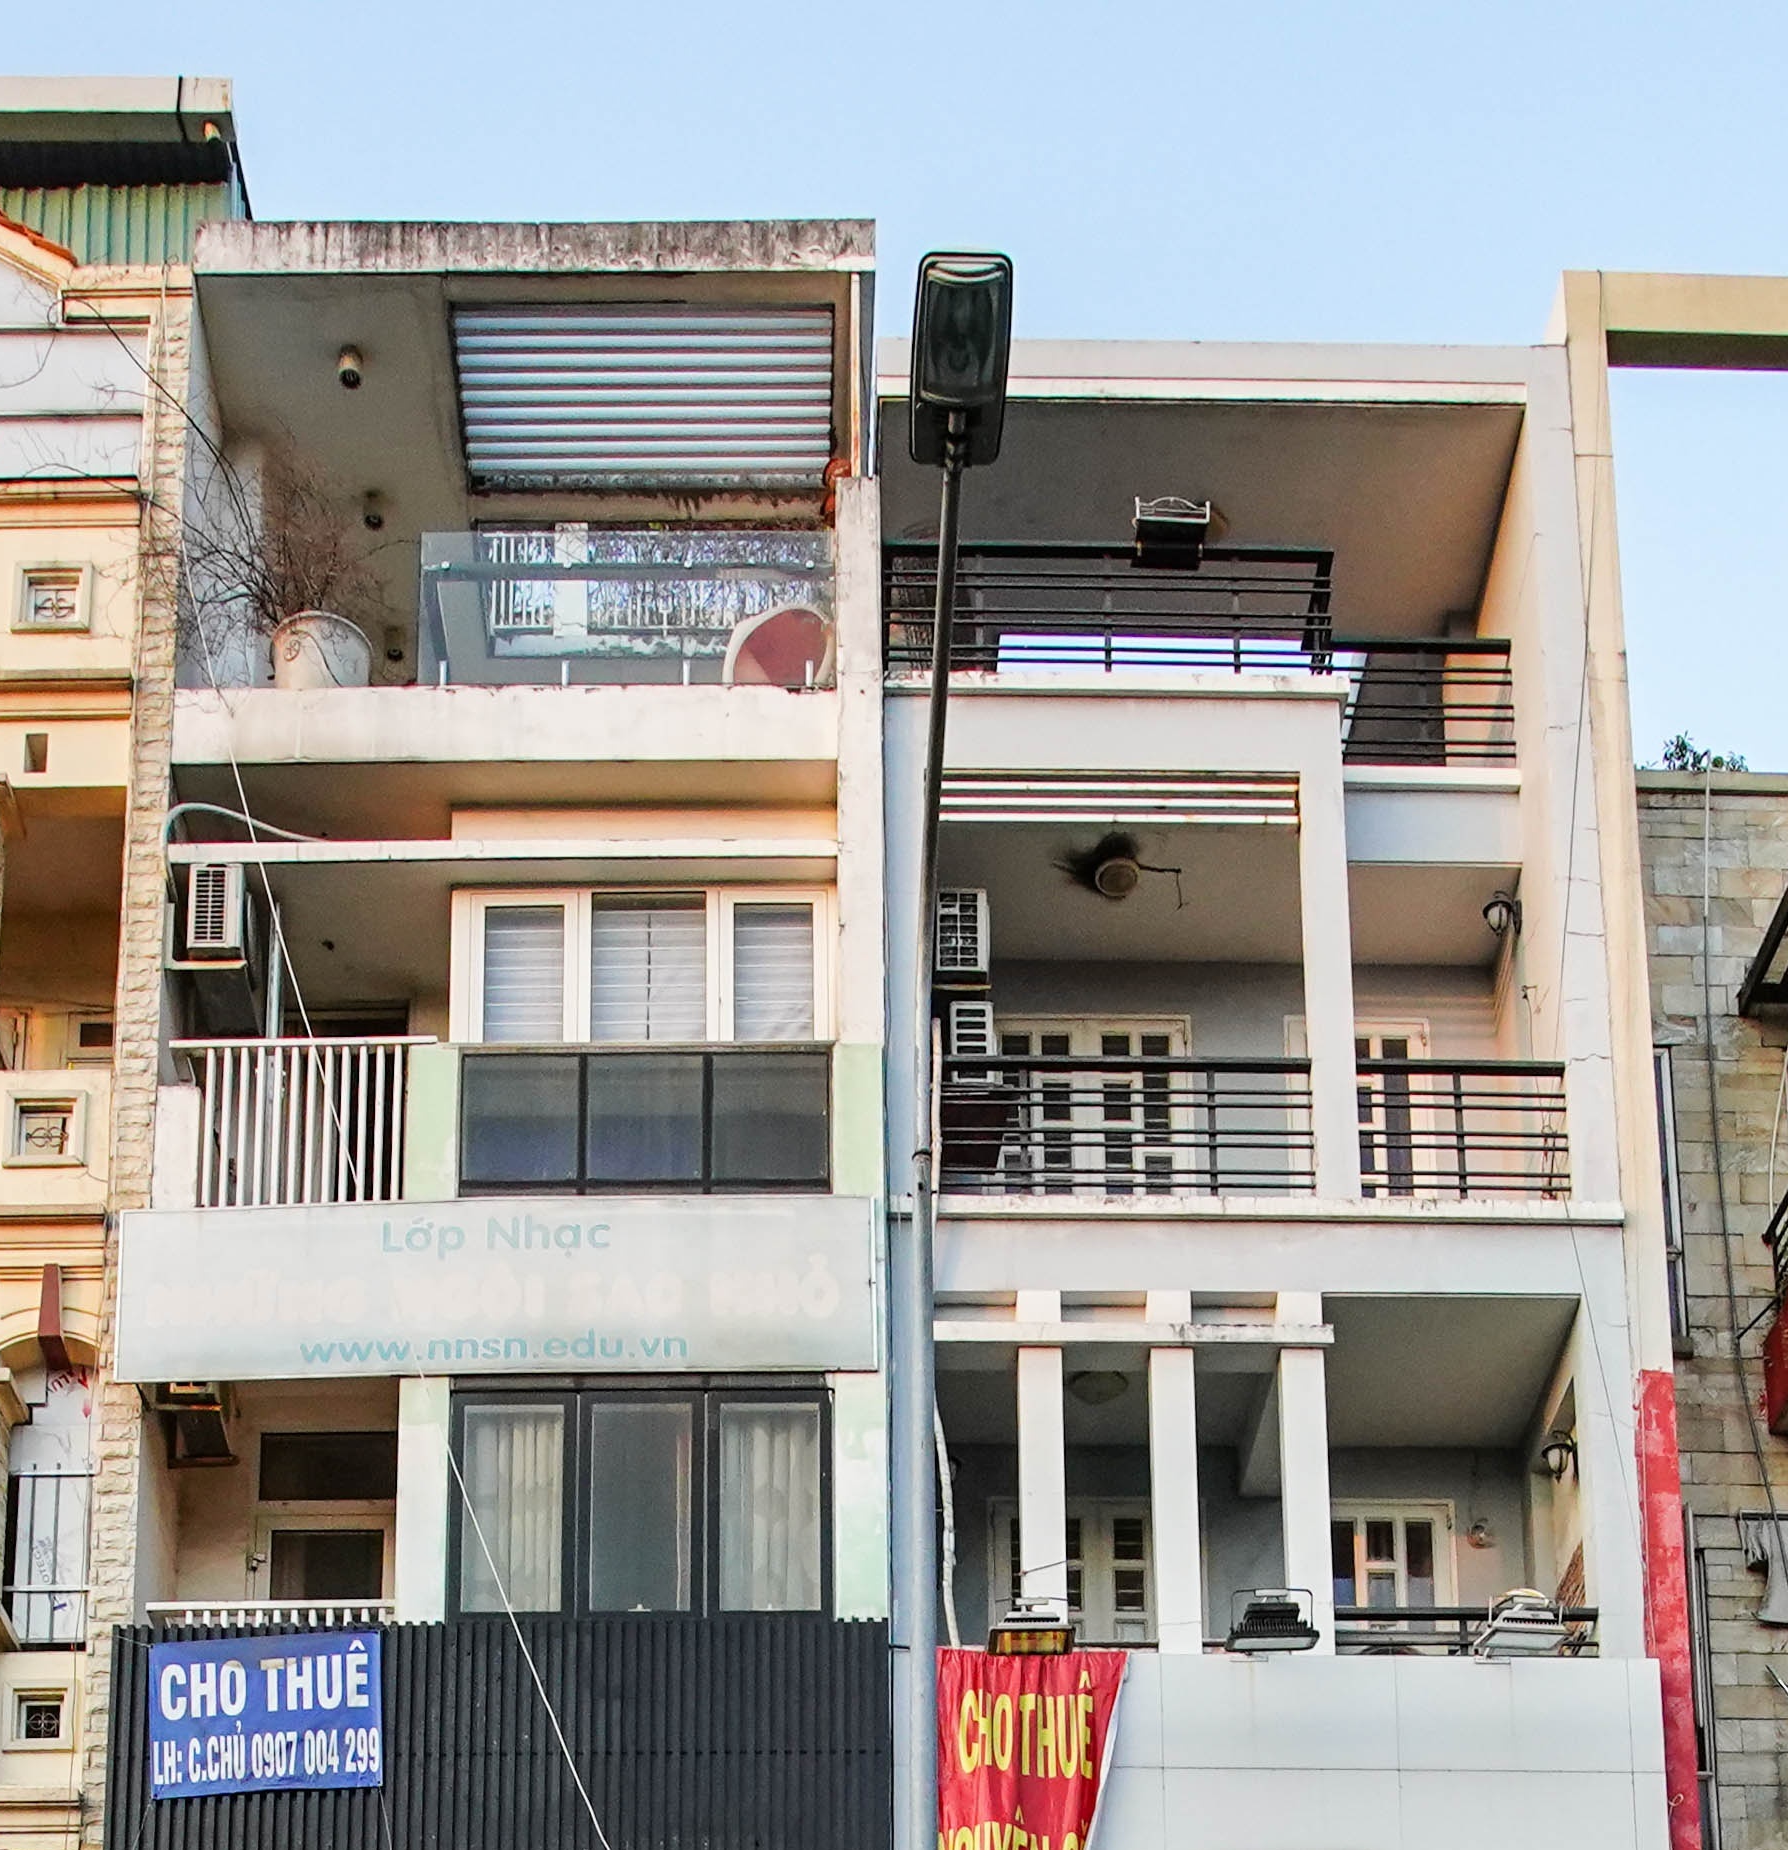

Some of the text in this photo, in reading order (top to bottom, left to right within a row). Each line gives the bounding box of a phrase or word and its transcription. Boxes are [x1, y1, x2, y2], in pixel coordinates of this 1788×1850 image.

[382, 1216, 612, 1261] Lớp Nhạc
[300, 1328, 688, 1363] www.nnsn.edu.vn
[161, 1640, 369, 1721] CHO THUÊ
[153, 1720, 380, 1784] LH: C.CHỦ 0907 004 299
[958, 1671, 1094, 1780] CHO THUÊ
